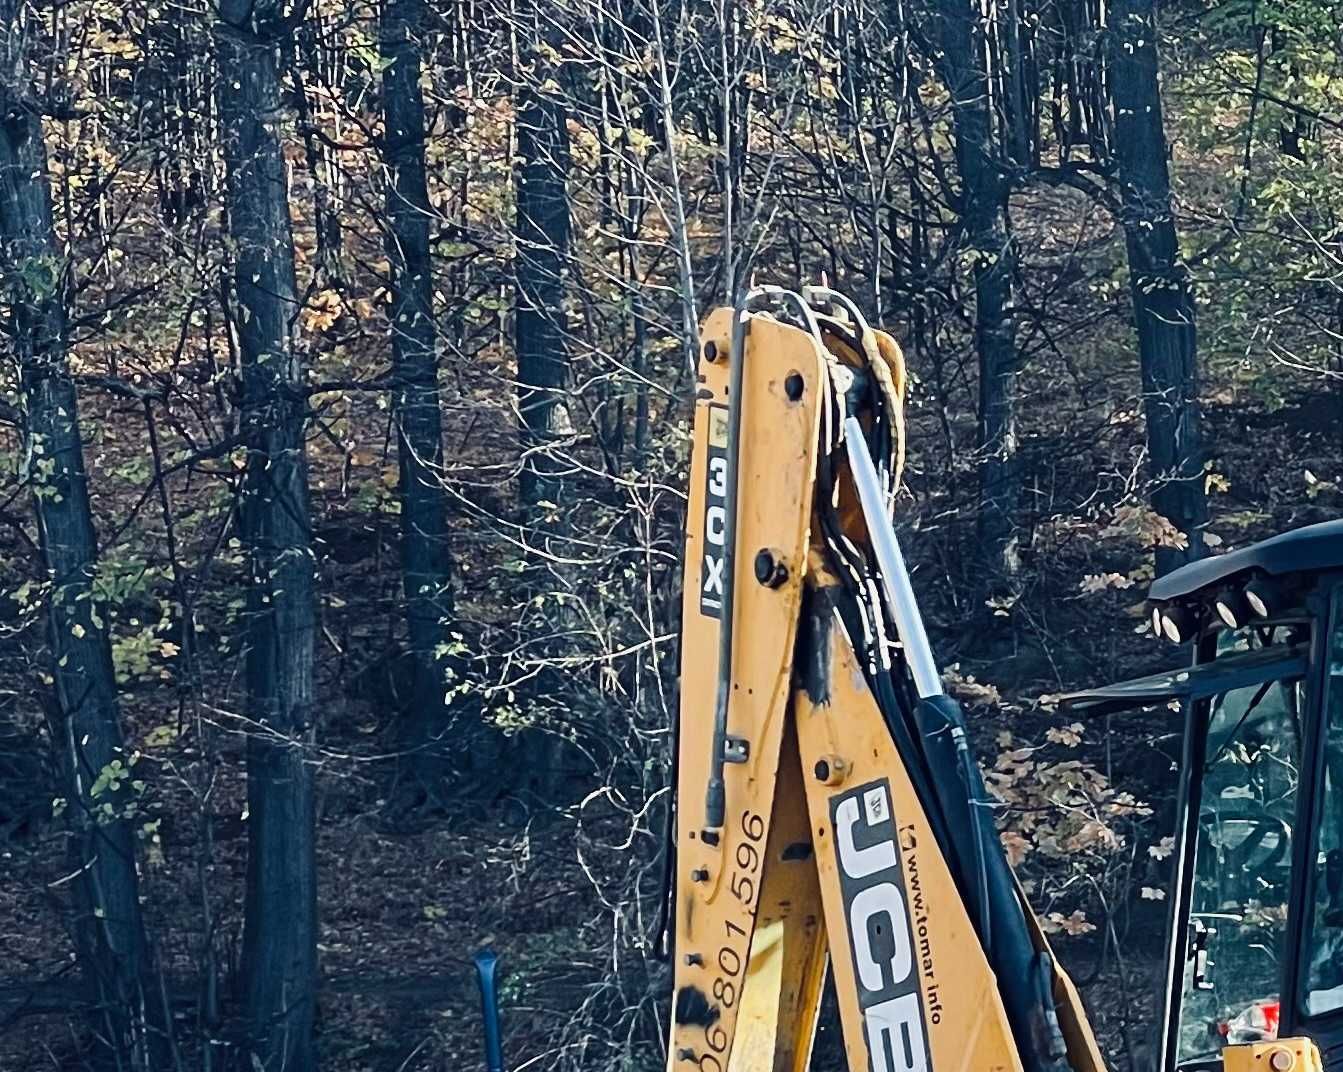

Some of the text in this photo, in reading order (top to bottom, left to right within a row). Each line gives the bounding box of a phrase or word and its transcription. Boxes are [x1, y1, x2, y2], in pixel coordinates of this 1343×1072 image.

[704, 456, 728, 595] 3CX
[712, 918, 747, 1009] 801
[730, 810, 764, 906] 596
[907, 854, 943, 1025] www.tomar info
